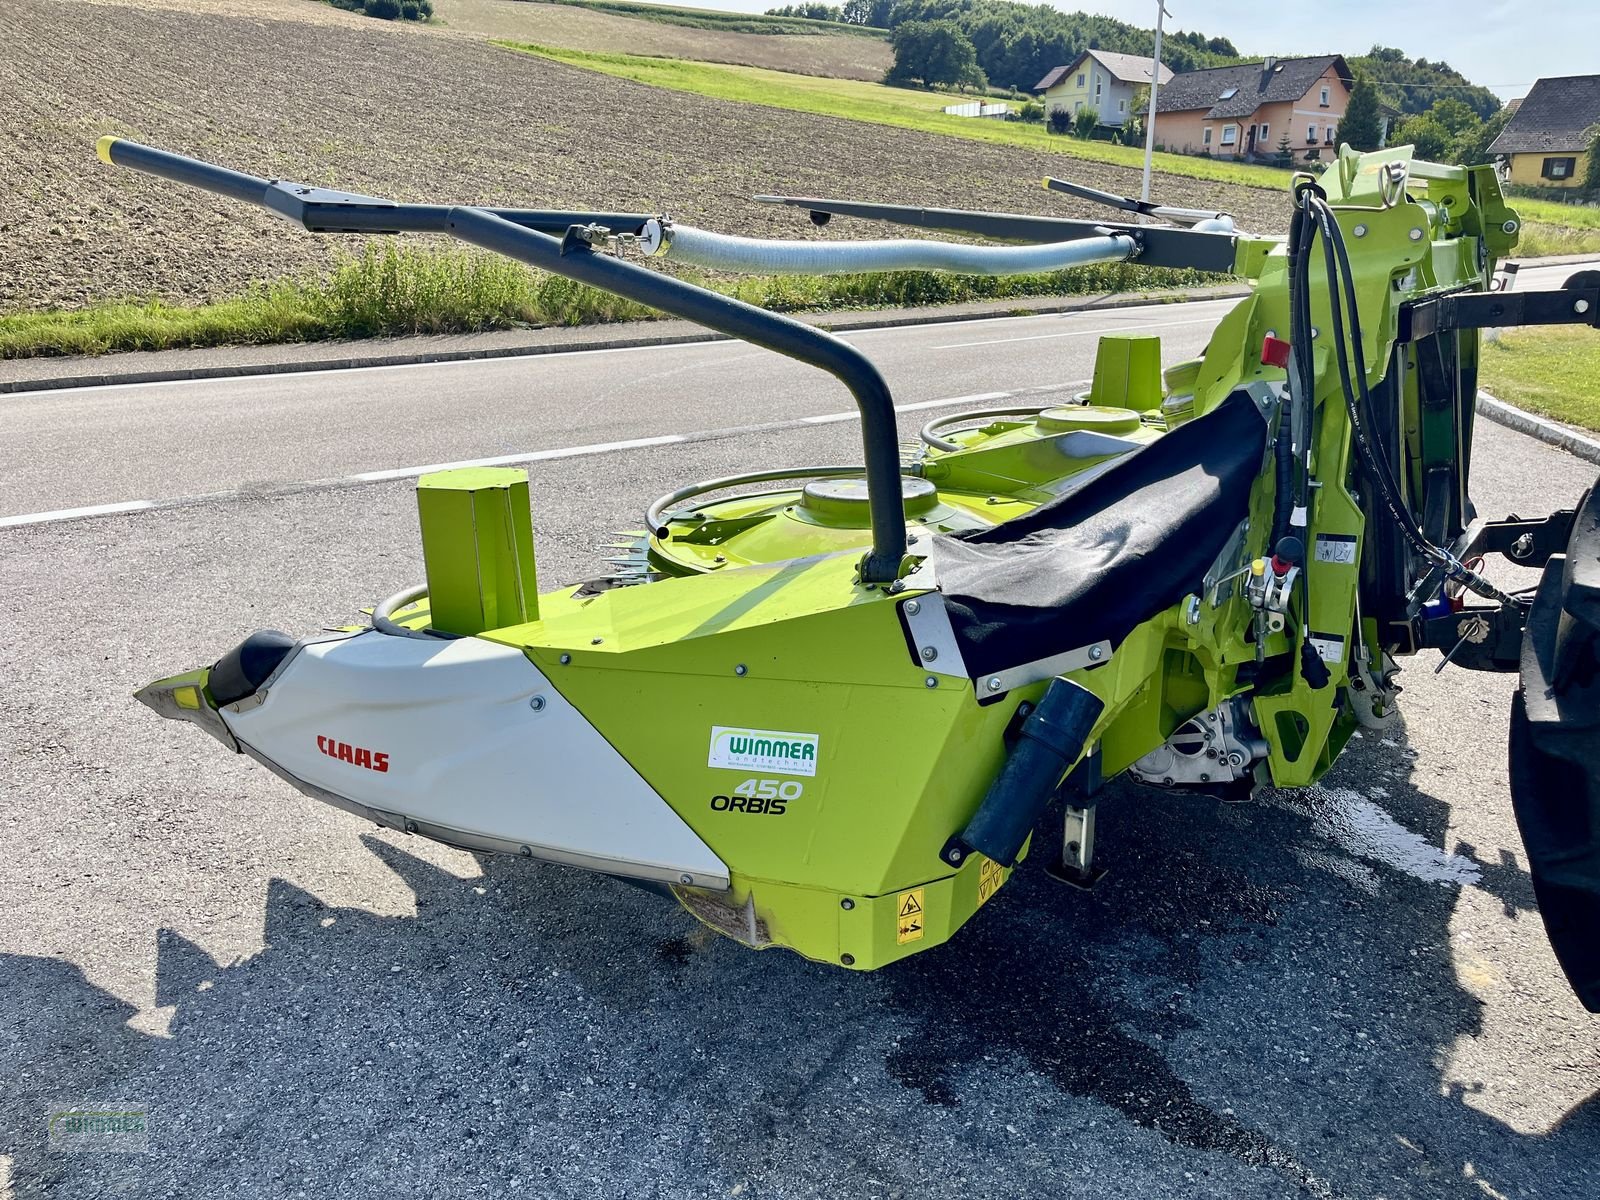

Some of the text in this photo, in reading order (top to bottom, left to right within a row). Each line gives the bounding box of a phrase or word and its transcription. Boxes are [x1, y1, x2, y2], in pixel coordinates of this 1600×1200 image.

[317, 735, 389, 773] CLAAS
[730, 737, 815, 761] WIMMER
[728, 755, 813, 768] Landtechnik
[734, 778, 804, 801] 450
[710, 795, 788, 815] ORBIS
